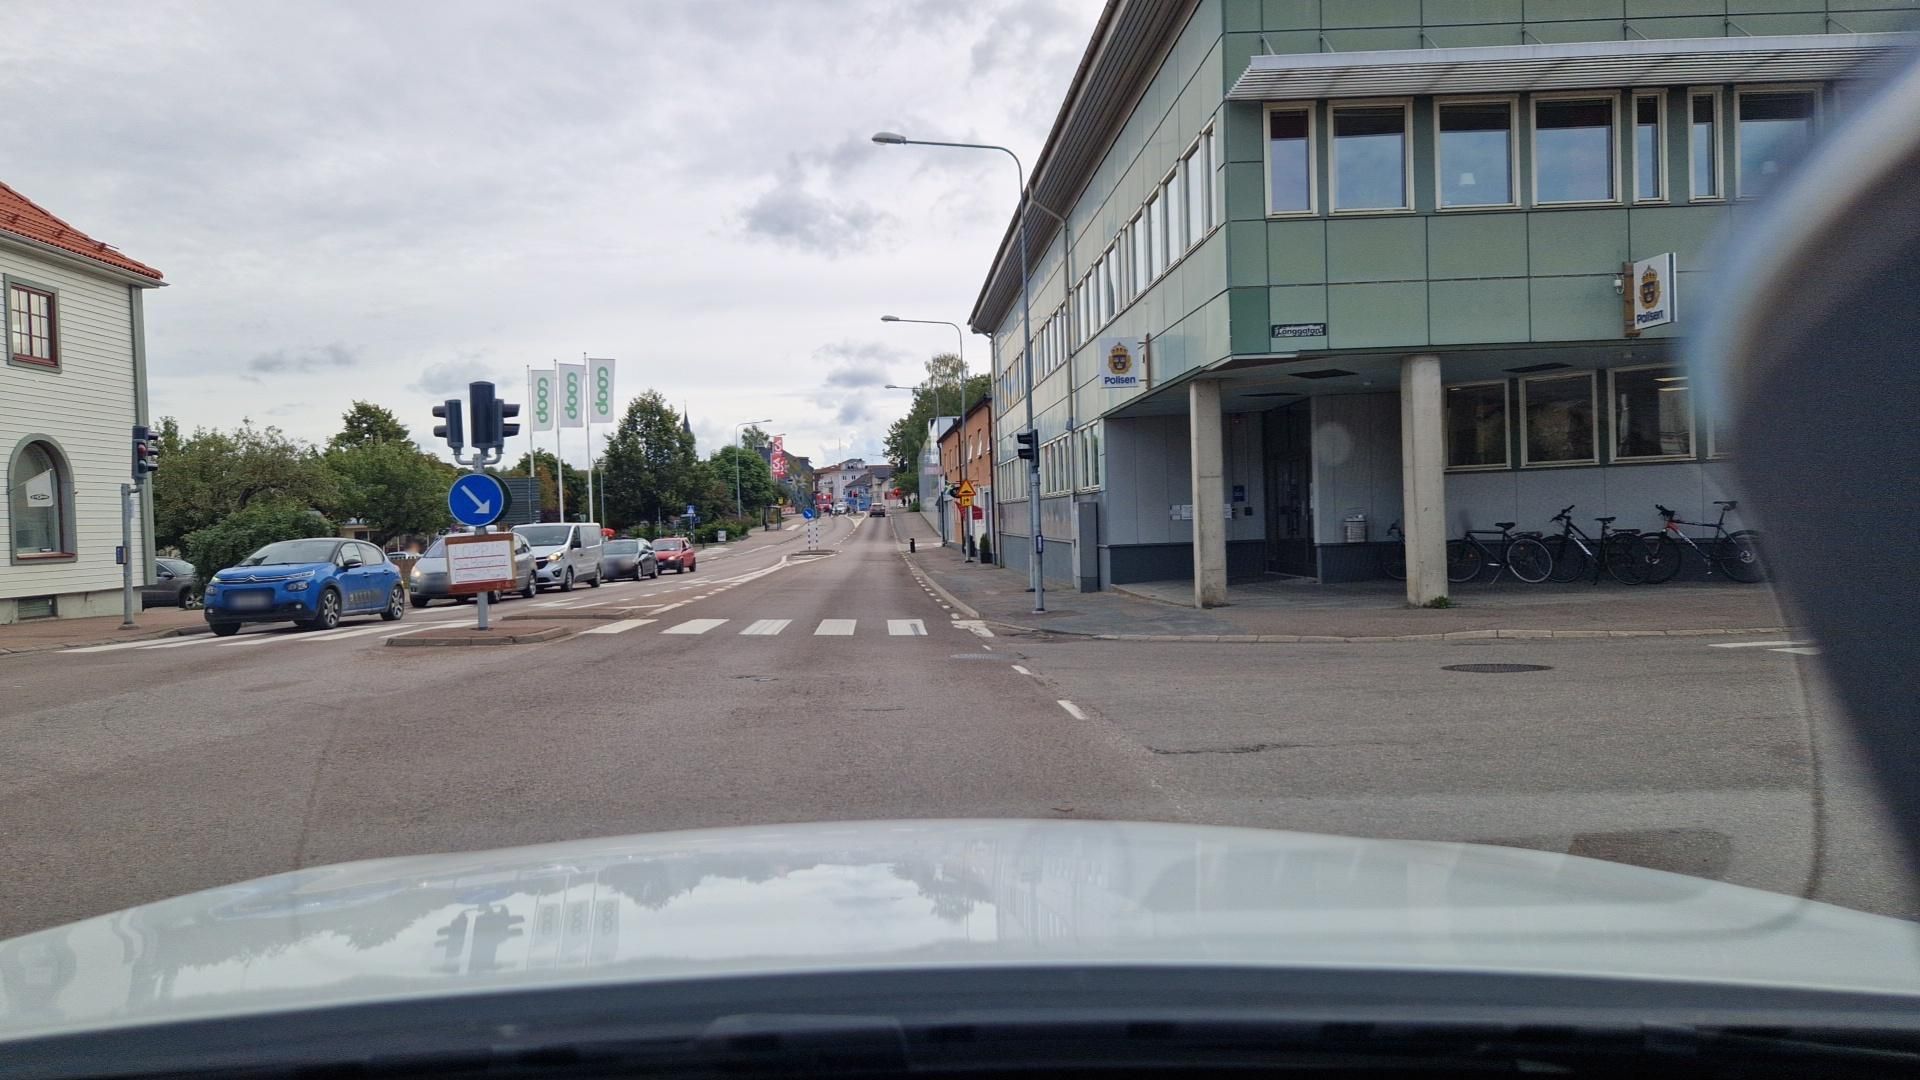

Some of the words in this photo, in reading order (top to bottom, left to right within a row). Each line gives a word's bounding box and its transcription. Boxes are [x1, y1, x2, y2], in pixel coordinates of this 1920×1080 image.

[1636, 309, 1664, 324] Polisen
[536, 377, 548, 423] coop
[565, 372, 577, 419] coop
[595, 367, 608, 415] coop
[1104, 376, 1136, 385] Polisen
